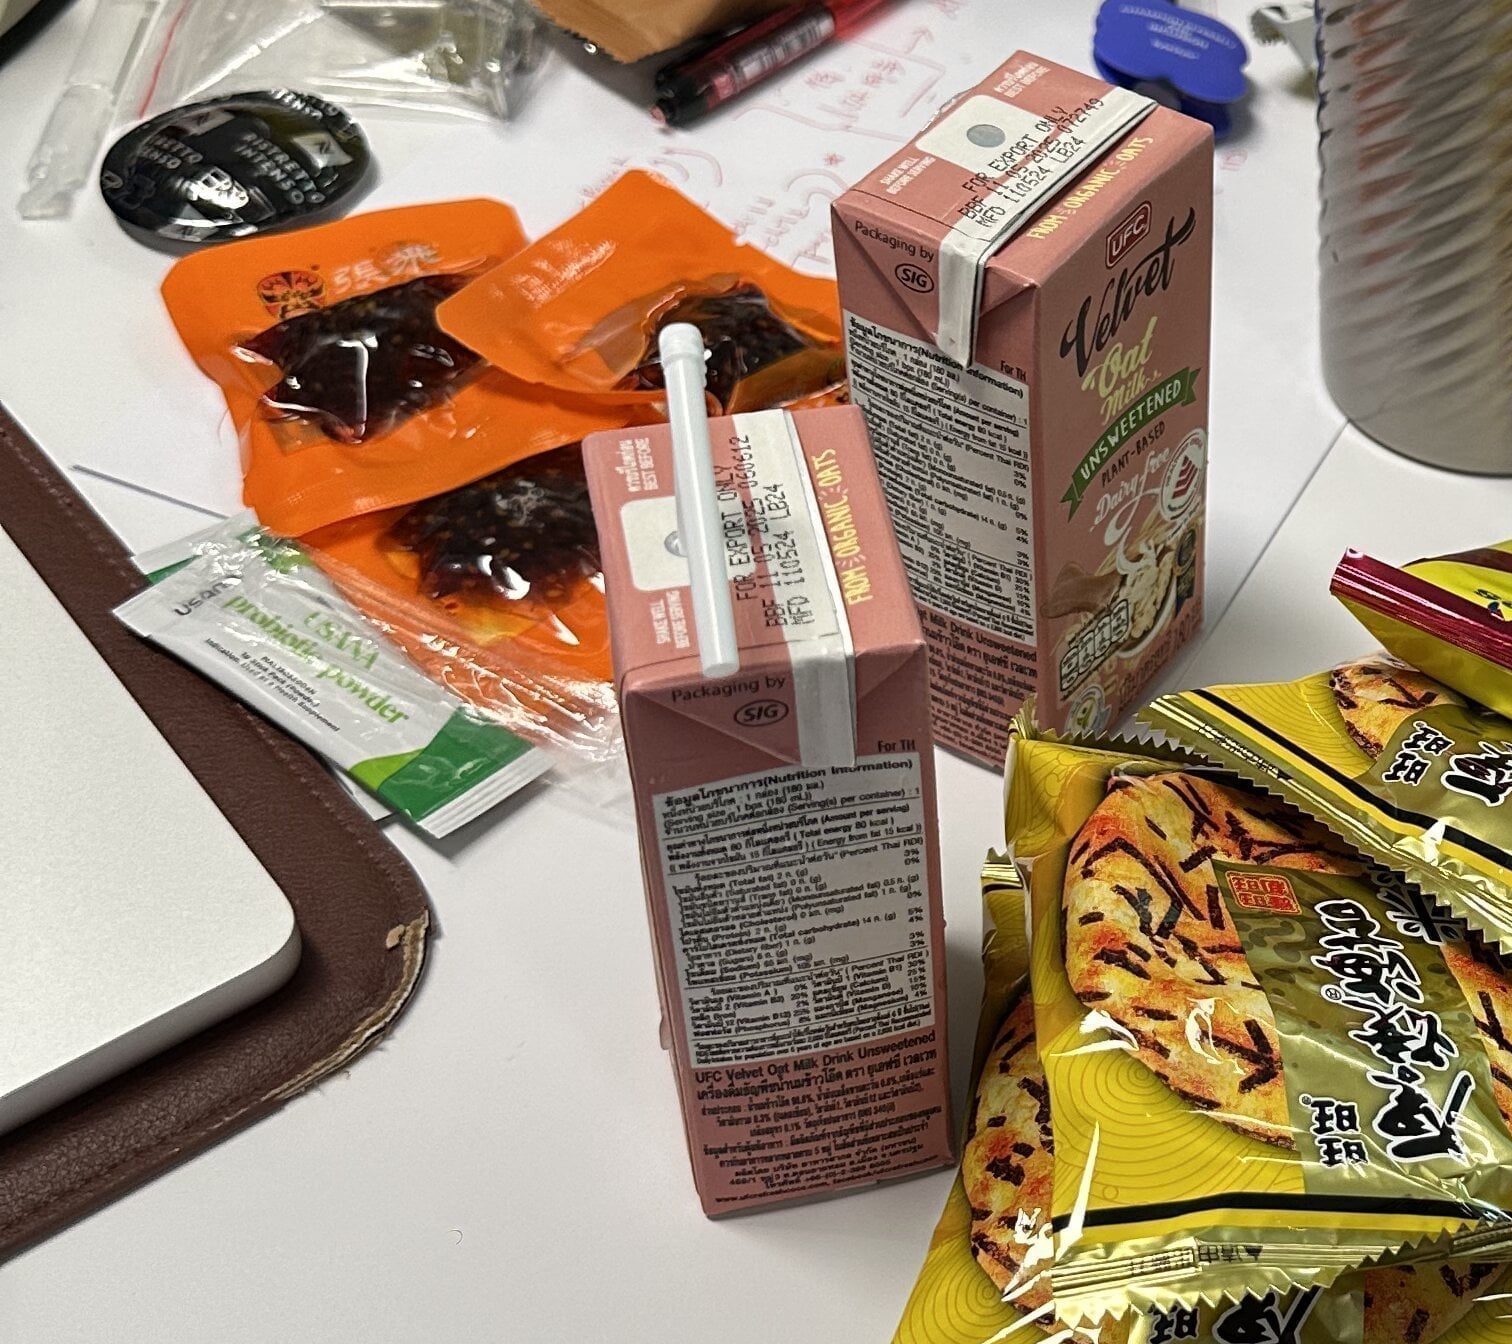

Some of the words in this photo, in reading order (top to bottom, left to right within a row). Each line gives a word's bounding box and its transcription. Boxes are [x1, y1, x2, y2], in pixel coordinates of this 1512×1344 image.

[234, 141, 304, 204] INTENSO
[962, 172, 990, 193] FOR
[988, 135, 1038, 172] EXPORT
[1034, 106, 1069, 133] ONLY
[1025, 137, 1060, 164] 2025
[1027, 212, 1068, 240] FROM
[1063, 167, 1122, 209] ORGANIC
[1116, 136, 1154, 162] OATS
[854, 219, 917, 258] Packaging
[919, 242, 936, 263] by
[1111, 221, 1148, 256] UFC
[900, 267, 929, 288] SIG
[1060, 207, 1196, 377] Velvet
[997, 360, 1014, 375] For
[1081, 316, 1158, 398] Oat
[1100, 374, 1147, 427] Milk
[1080, 378, 1182, 481] UNSWEETENED
[1101, 421, 1166, 489] PLANT-BASED
[715, 464, 738, 502] ONLY
[811, 448, 843, 488] OATS
[721, 511, 753, 568] EXPORT
[823, 494, 861, 559] ORGANIC
[734, 571, 758, 601] FOR
[842, 564, 874, 605] FROM
[223, 593, 323, 669] probiotic
[314, 657, 412, 727] powder
[303, 609, 383, 672] USANA
[672, 679, 760, 703] Packaging
[766, 675, 786, 690] by
[744, 705, 779, 723] SIG
[877, 737, 899, 753] For
[900, 738, 915, 750] TH
[1382, 720, 1456, 787] 旺旺
[694, 1070, 722, 1085] UFC
[725, 1064, 764, 1082] Velvet
[792, 1055, 817, 1071] Milk
[821, 1050, 854, 1066] Drink
[855, 1030, 937, 1059] Unsweetened
[1309, 1099, 1370, 1168] 旺旺
